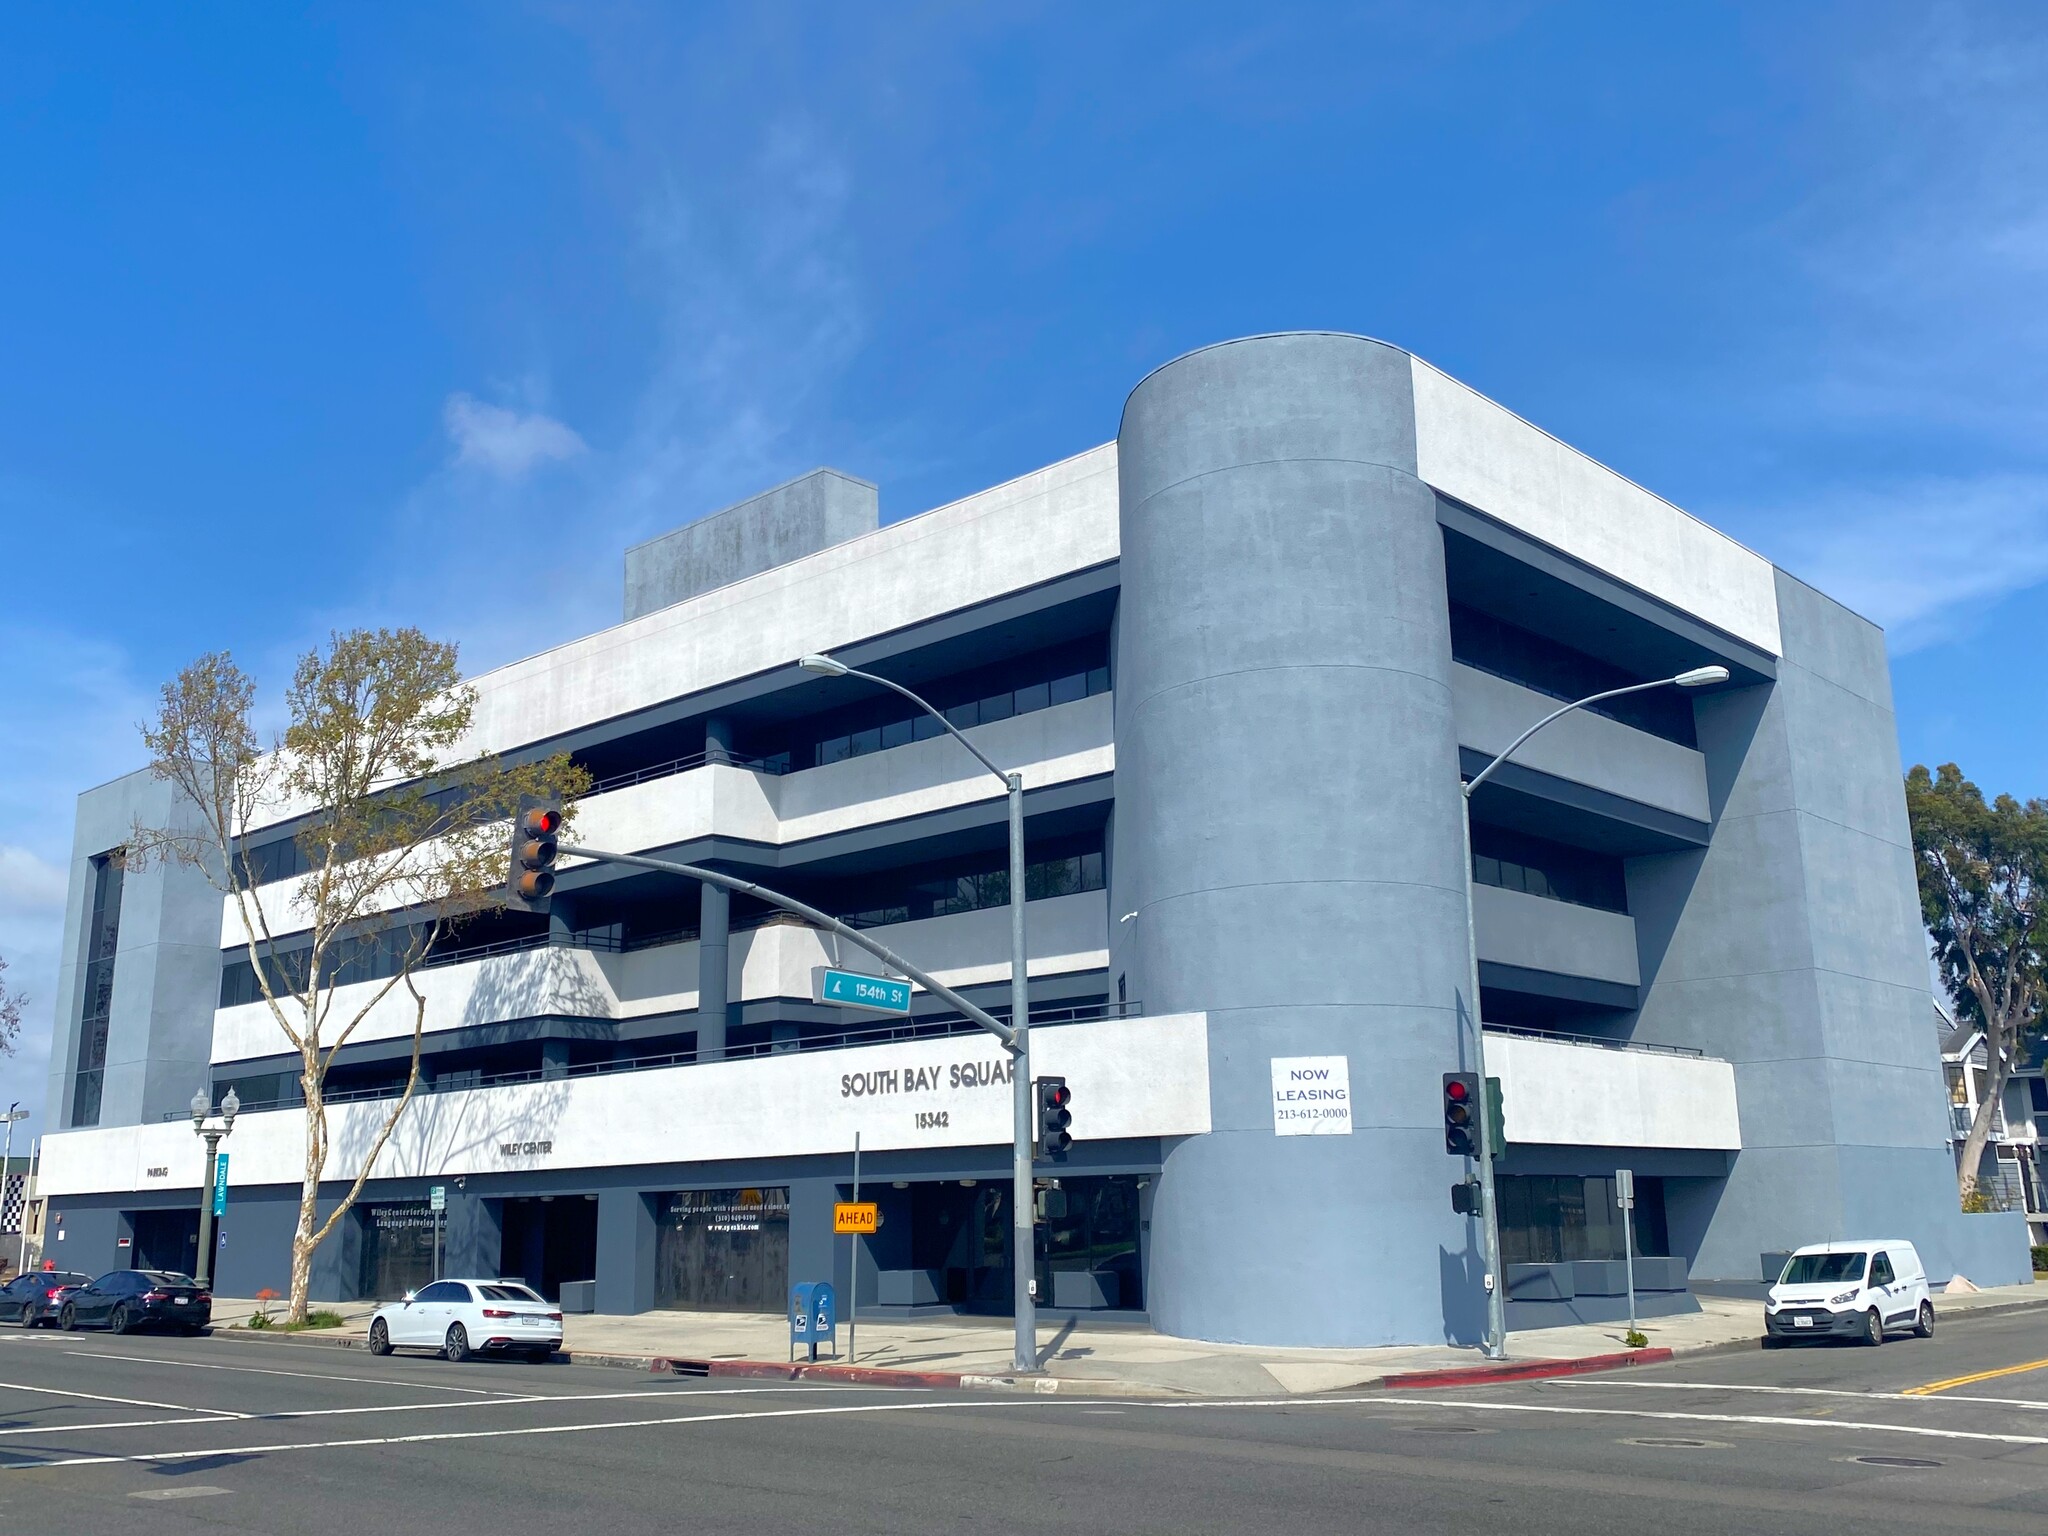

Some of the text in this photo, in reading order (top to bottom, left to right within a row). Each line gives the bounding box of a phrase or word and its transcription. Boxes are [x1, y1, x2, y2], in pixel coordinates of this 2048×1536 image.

[856, 983, 902, 1003] 154th St
[841, 1059, 1015, 1097] SOUTH BAY SQUAR
[1291, 1069, 1329, 1080] NOW
[1276, 1089, 1346, 1101] LEASING
[915, 1111, 949, 1129] 15342
[1278, 1108, 1348, 1119] 213-612-0000
[500, 1141, 552, 1157] WILEY CENTER
[217, 1161, 227, 1202] LAWNDALE
[376, 1219, 406, 1229] Language
[838, 1212, 873, 1224] AHEAD
